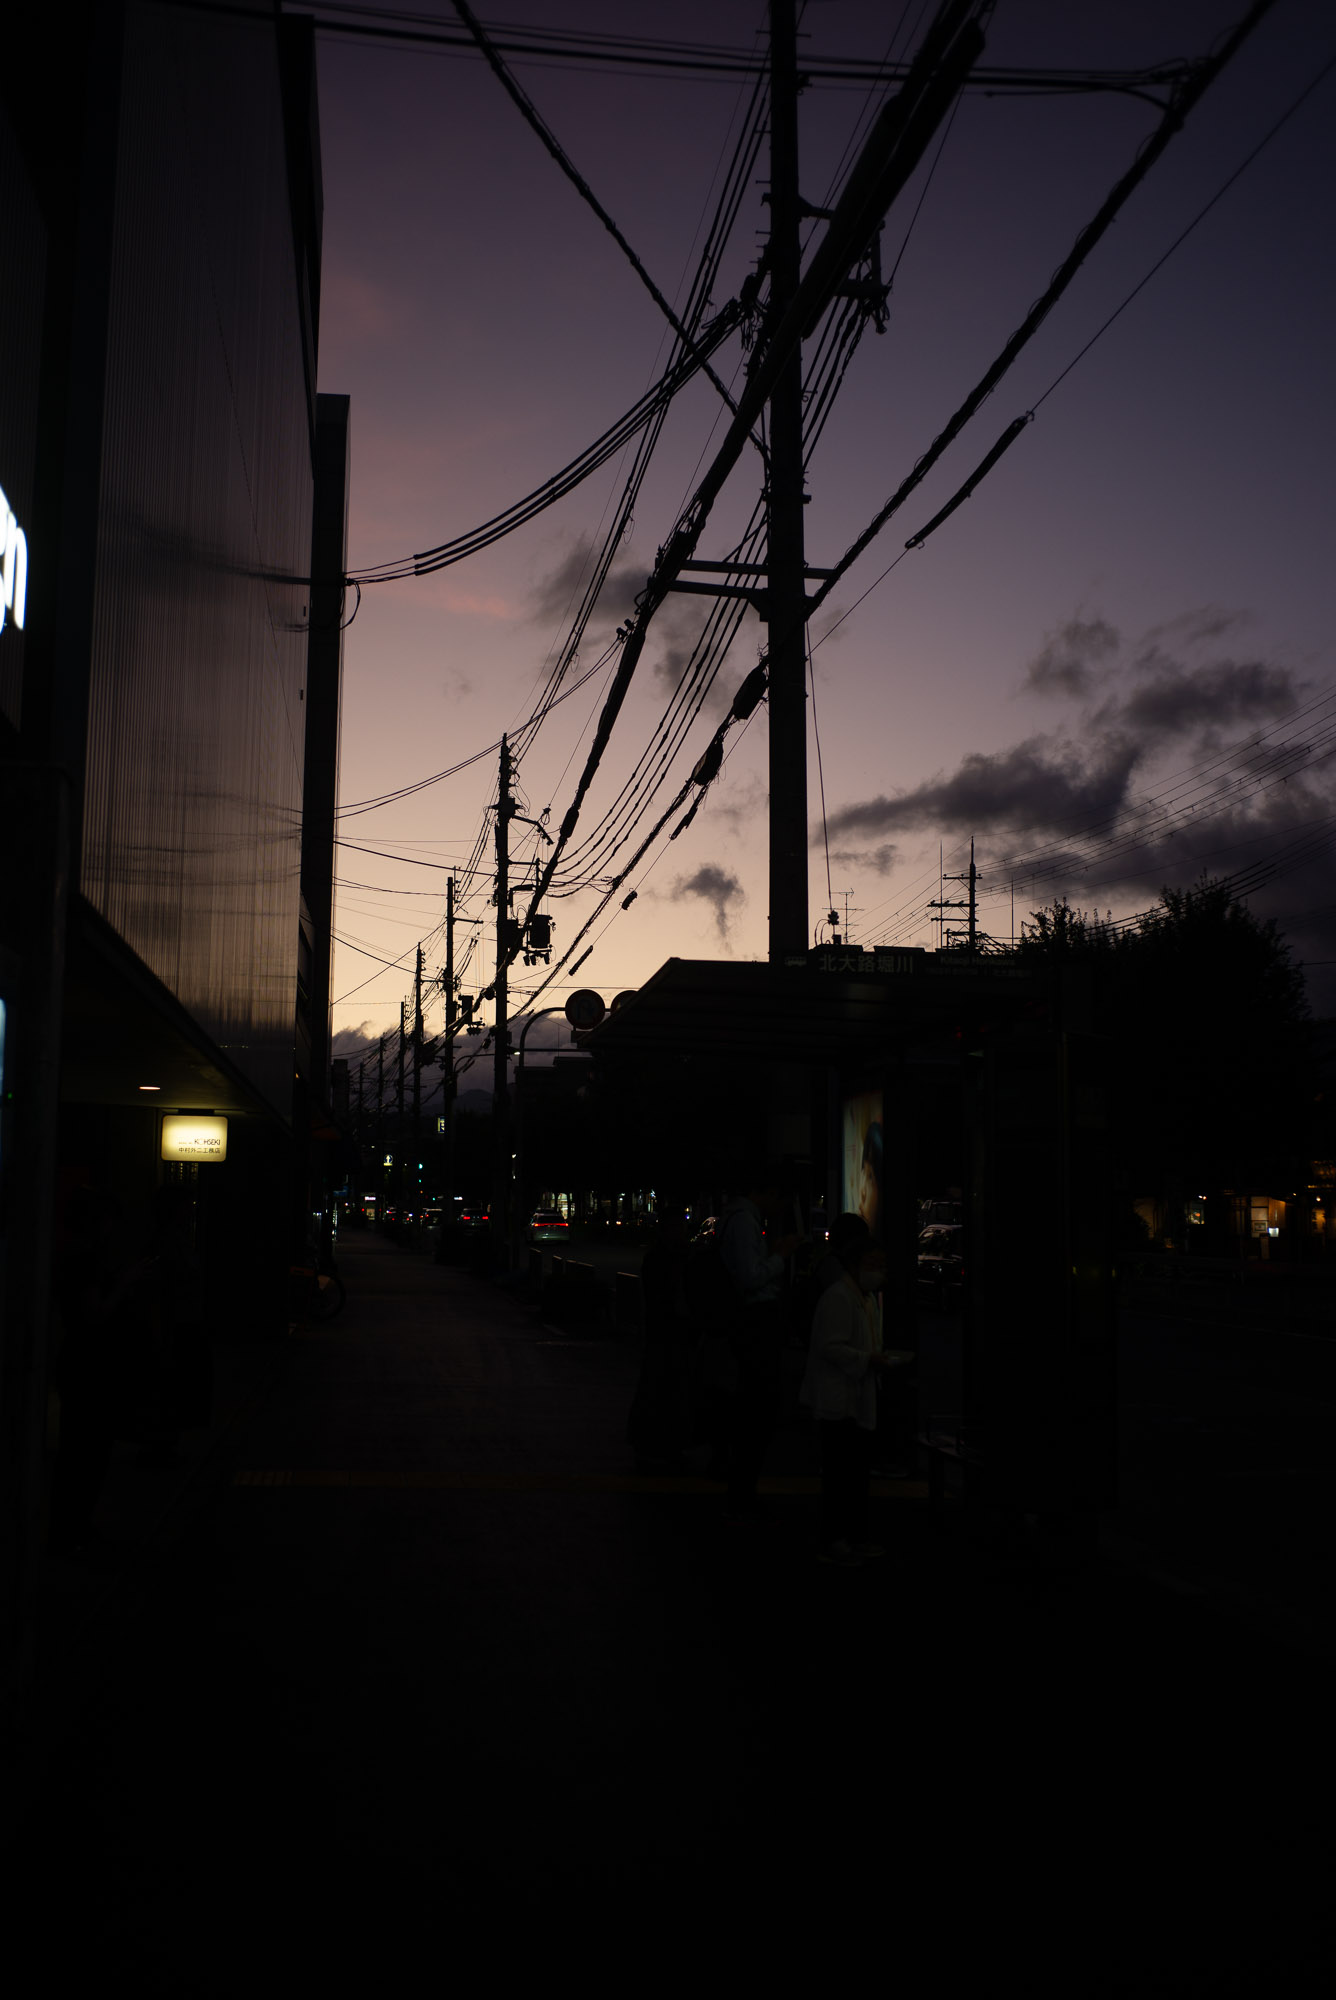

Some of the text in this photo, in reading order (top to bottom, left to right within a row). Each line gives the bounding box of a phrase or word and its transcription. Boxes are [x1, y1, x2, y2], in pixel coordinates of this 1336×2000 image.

[819, 955, 914, 974] 北大路堀川
